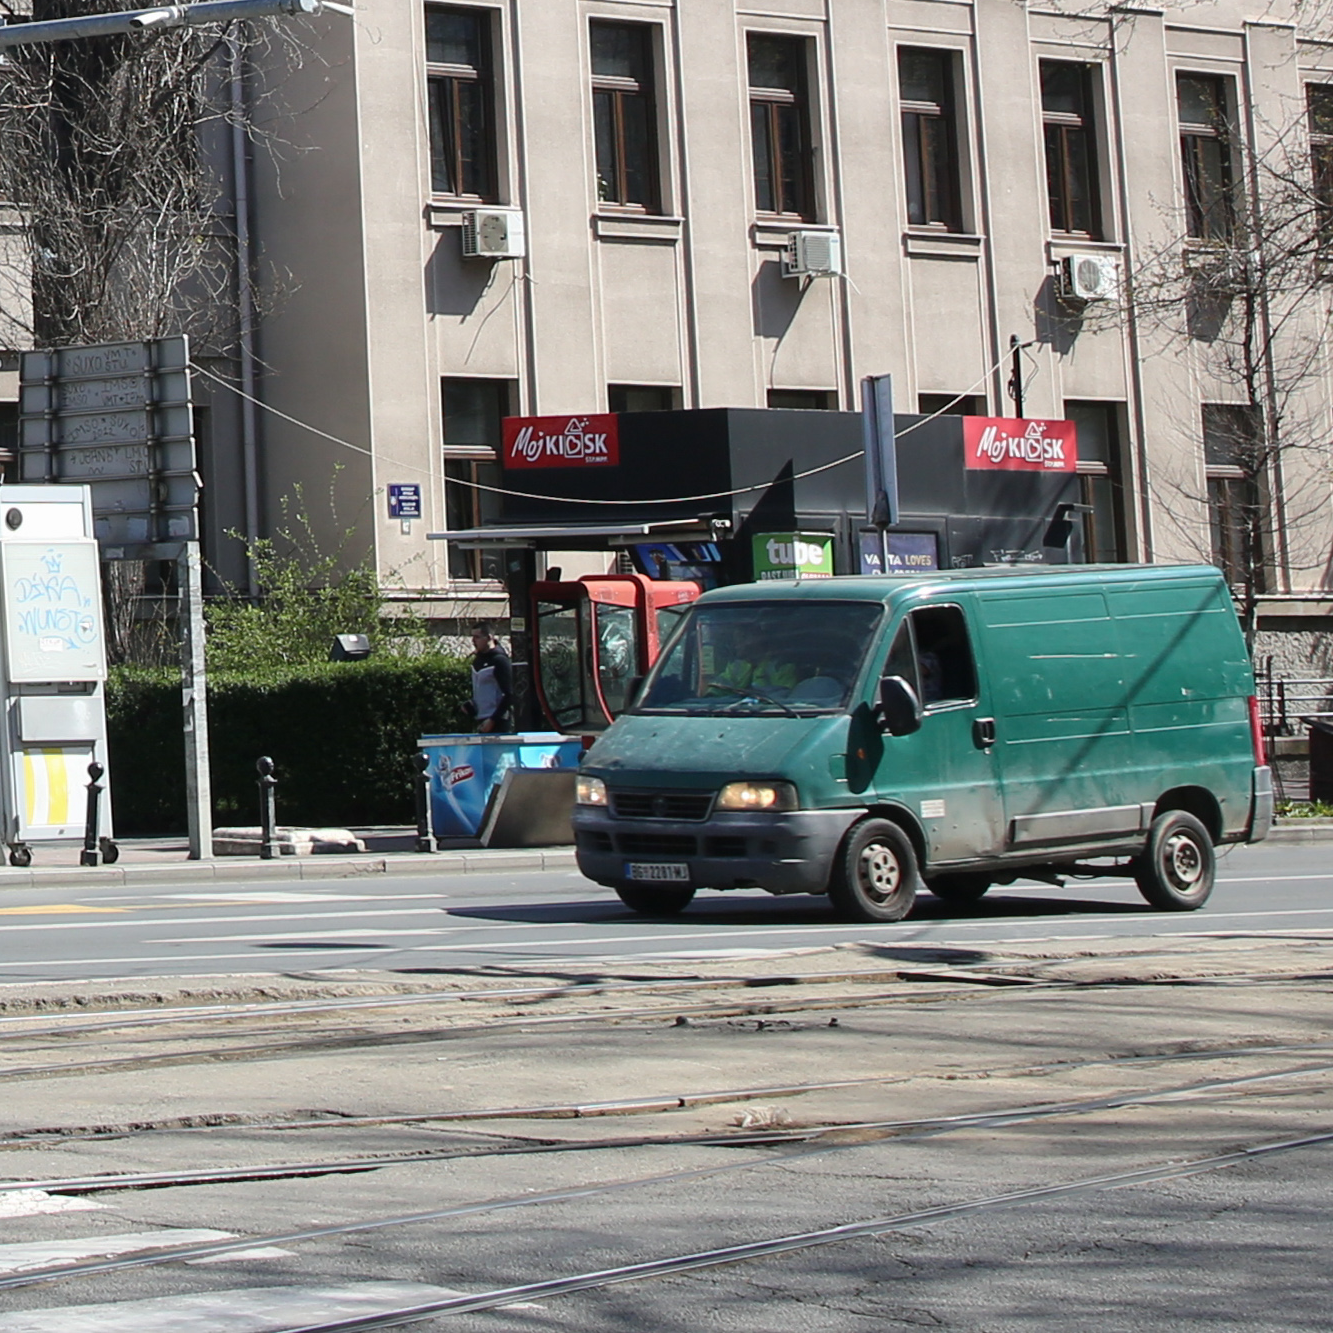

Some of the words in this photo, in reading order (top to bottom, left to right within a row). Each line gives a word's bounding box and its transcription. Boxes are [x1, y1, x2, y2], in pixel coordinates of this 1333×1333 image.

[511, 426, 545, 462] Moj
[545, 430, 609, 459] KIOSK
[976, 426, 1008, 463] Moj
[1008, 435, 1065, 462] KIOSK
[766, 537, 823, 565] tube
[864, 553, 903, 566] VATA
[905, 554, 932, 566] LOVES
